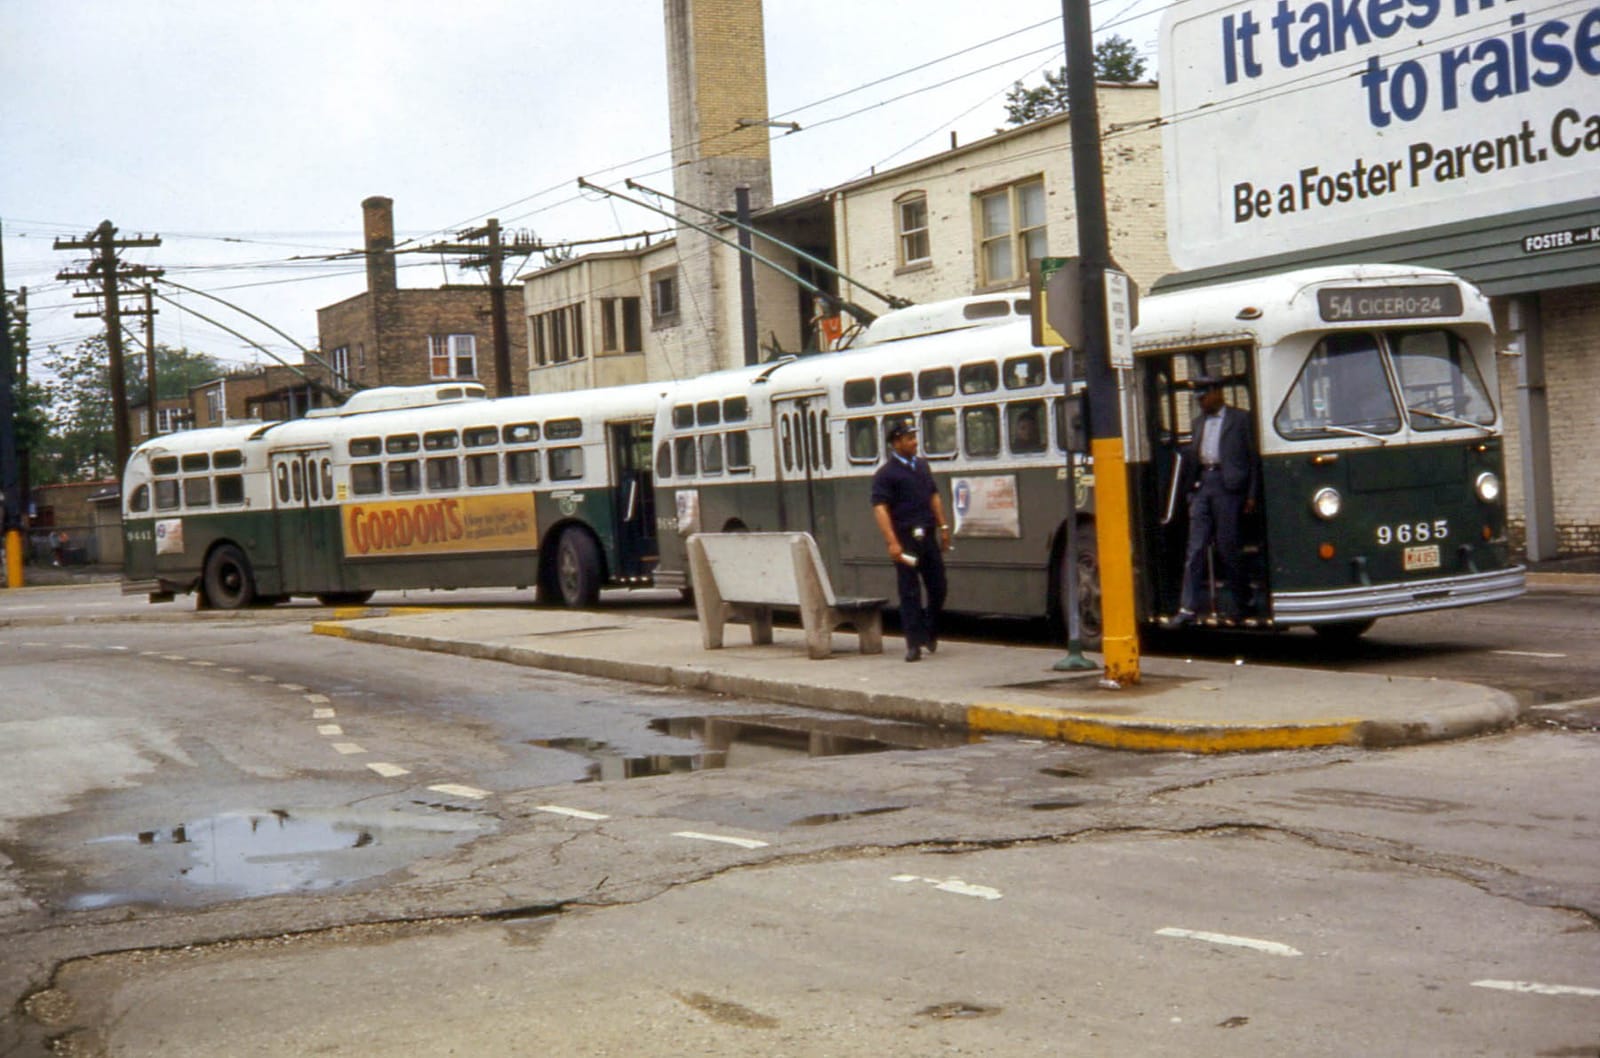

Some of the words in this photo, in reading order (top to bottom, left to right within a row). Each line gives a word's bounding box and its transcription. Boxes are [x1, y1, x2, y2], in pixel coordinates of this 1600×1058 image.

[1222, 10, 1262, 85] It
[1361, 55, 1428, 128] to
[1440, 7, 1600, 112] raise
[1233, 182, 1272, 224] Be
[1277, 183, 1296, 215] a
[1299, 157, 1403, 210] Foster
[1409, 120, 1548, 188] Parent.
[1526, 231, 1574, 252] FOSTER
[1329, 296, 1353, 319] 54
[1377, 519, 1449, 545] 9685
